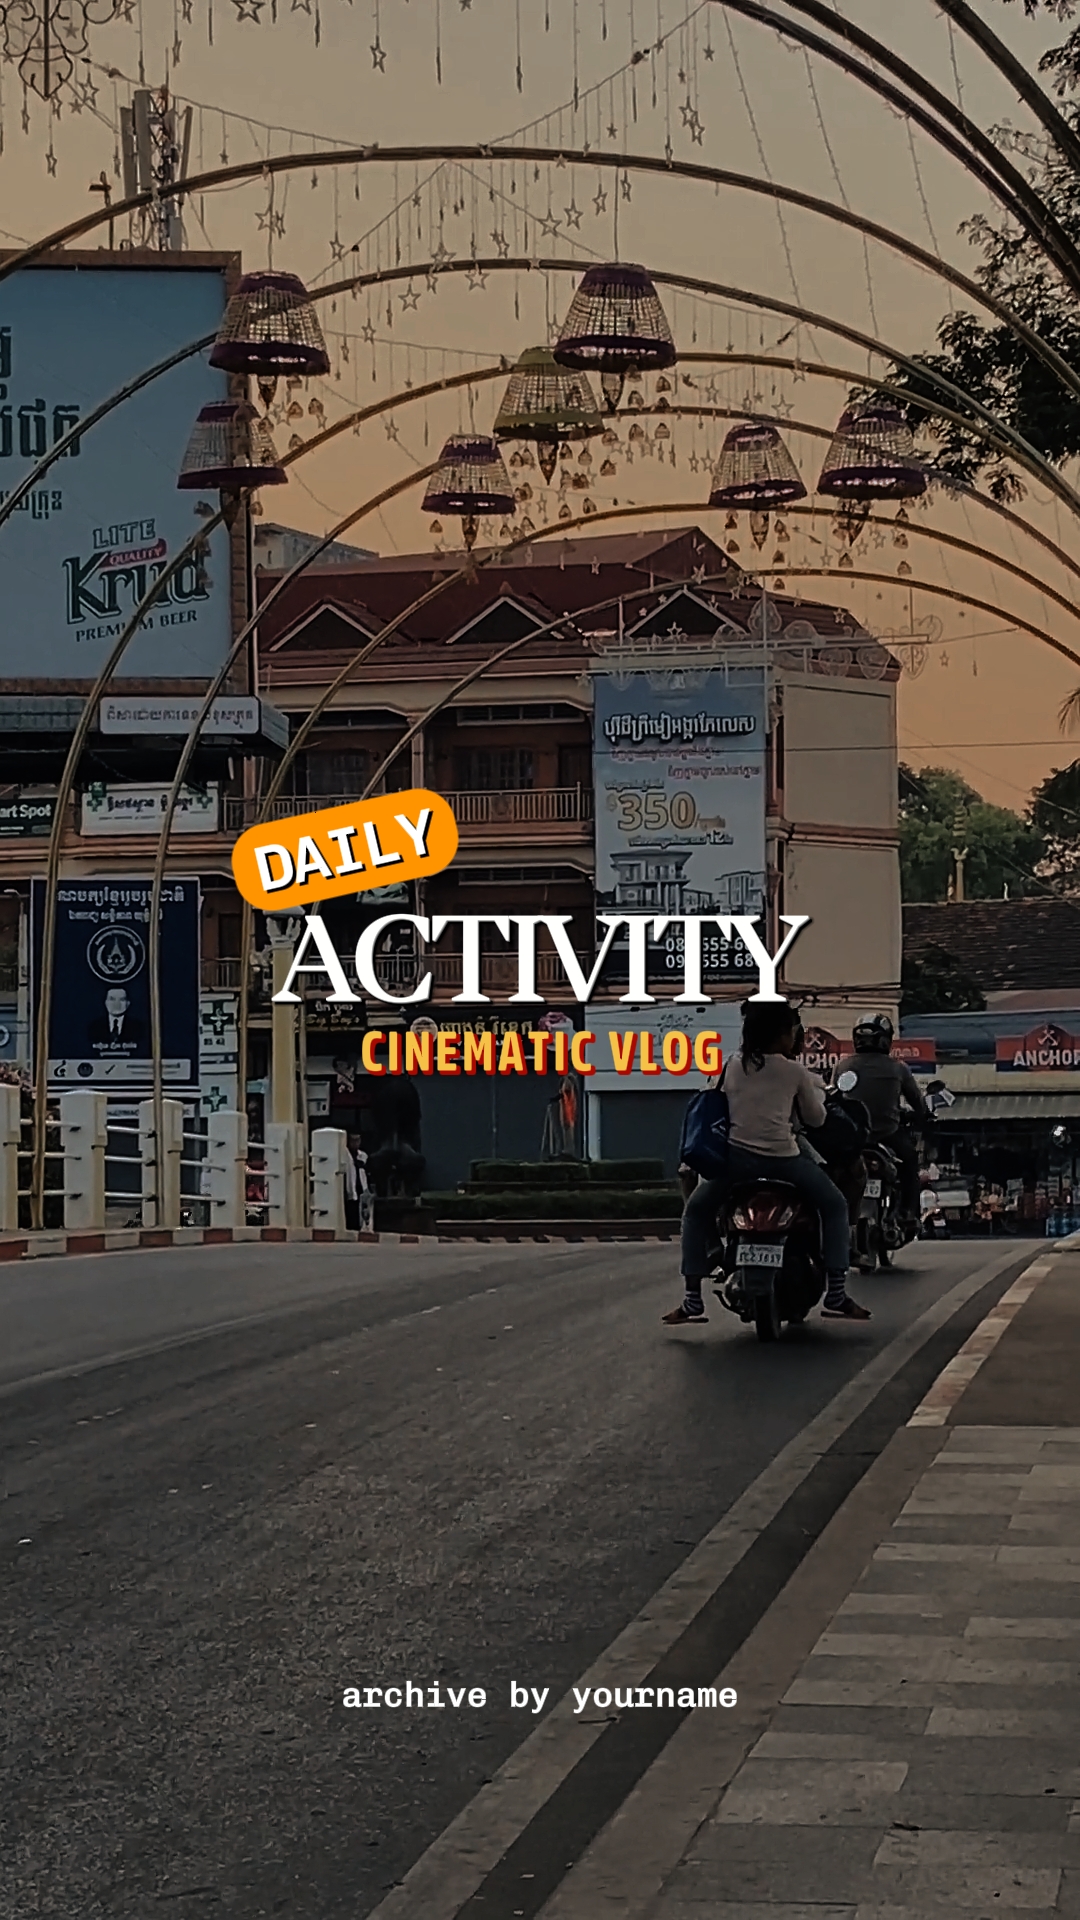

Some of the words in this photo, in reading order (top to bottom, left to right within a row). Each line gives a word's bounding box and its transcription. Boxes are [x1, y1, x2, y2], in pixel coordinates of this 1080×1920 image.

[92, 517, 157, 550] LITE
[61, 547, 211, 626] Krud
[75, 616, 154, 643] PREMM
[160, 609, 199, 627] BEER
[19, 804, 52, 820] Spot
[665, 937, 686, 953] 08
[665, 954, 686, 969] 09
[703, 953, 730, 968] 555
[734, 953, 760, 968] 68
